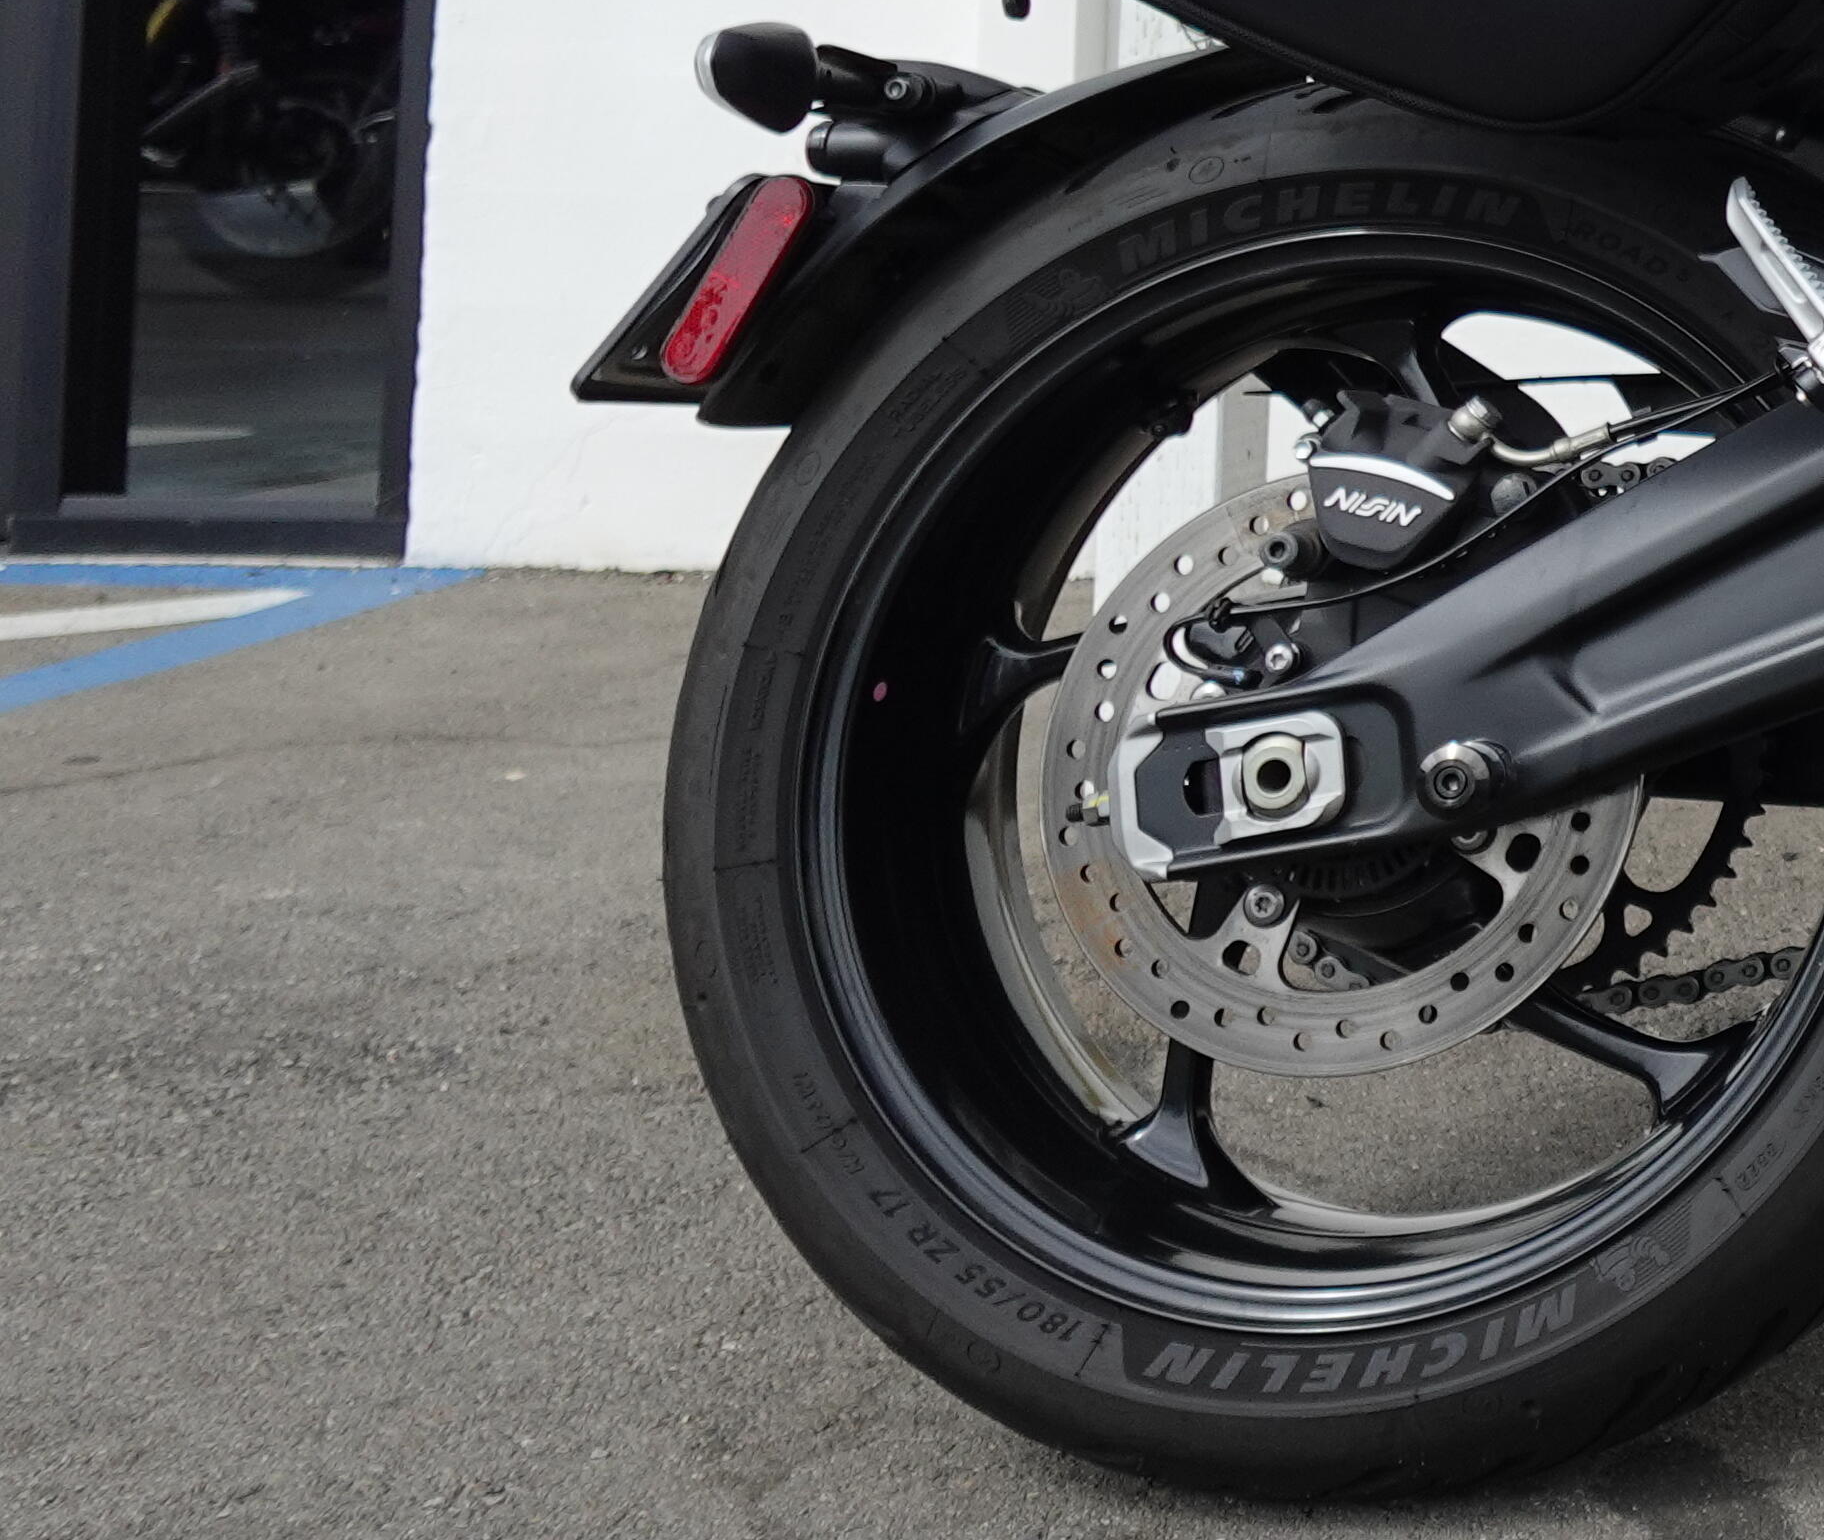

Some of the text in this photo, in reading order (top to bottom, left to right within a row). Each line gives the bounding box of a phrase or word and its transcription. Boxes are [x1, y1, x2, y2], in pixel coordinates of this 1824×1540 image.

[1117, 179, 1524, 274] MICHELIN
[956, 1263, 1084, 1344] 180/55
[1144, 1280, 1578, 1393] MICHELIN
